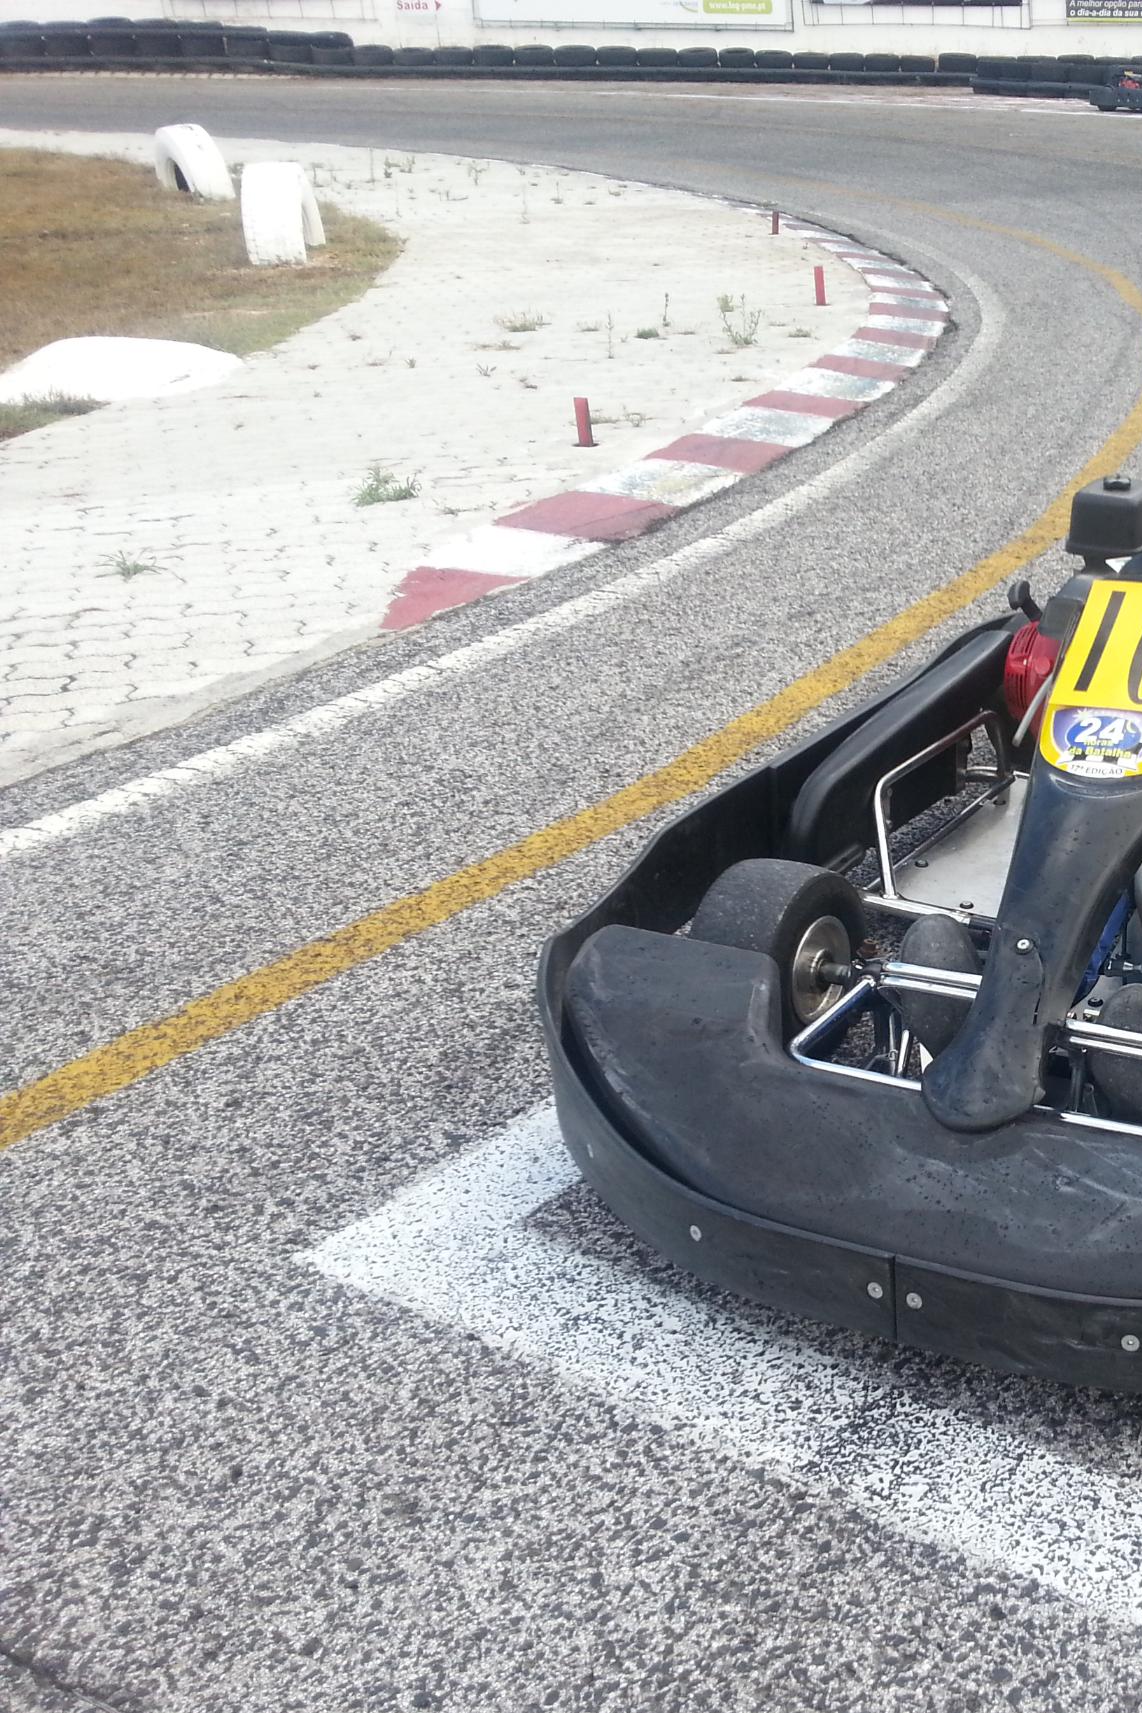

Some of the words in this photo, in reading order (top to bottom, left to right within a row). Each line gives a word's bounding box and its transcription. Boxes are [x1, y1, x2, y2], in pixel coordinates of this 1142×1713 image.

[1077, 9, 1111, 17] dia-a-dia
[1113, 9, 1123, 17] da
[1075, 716, 1126, 744] 24
[1069, 746, 1082, 755] da
